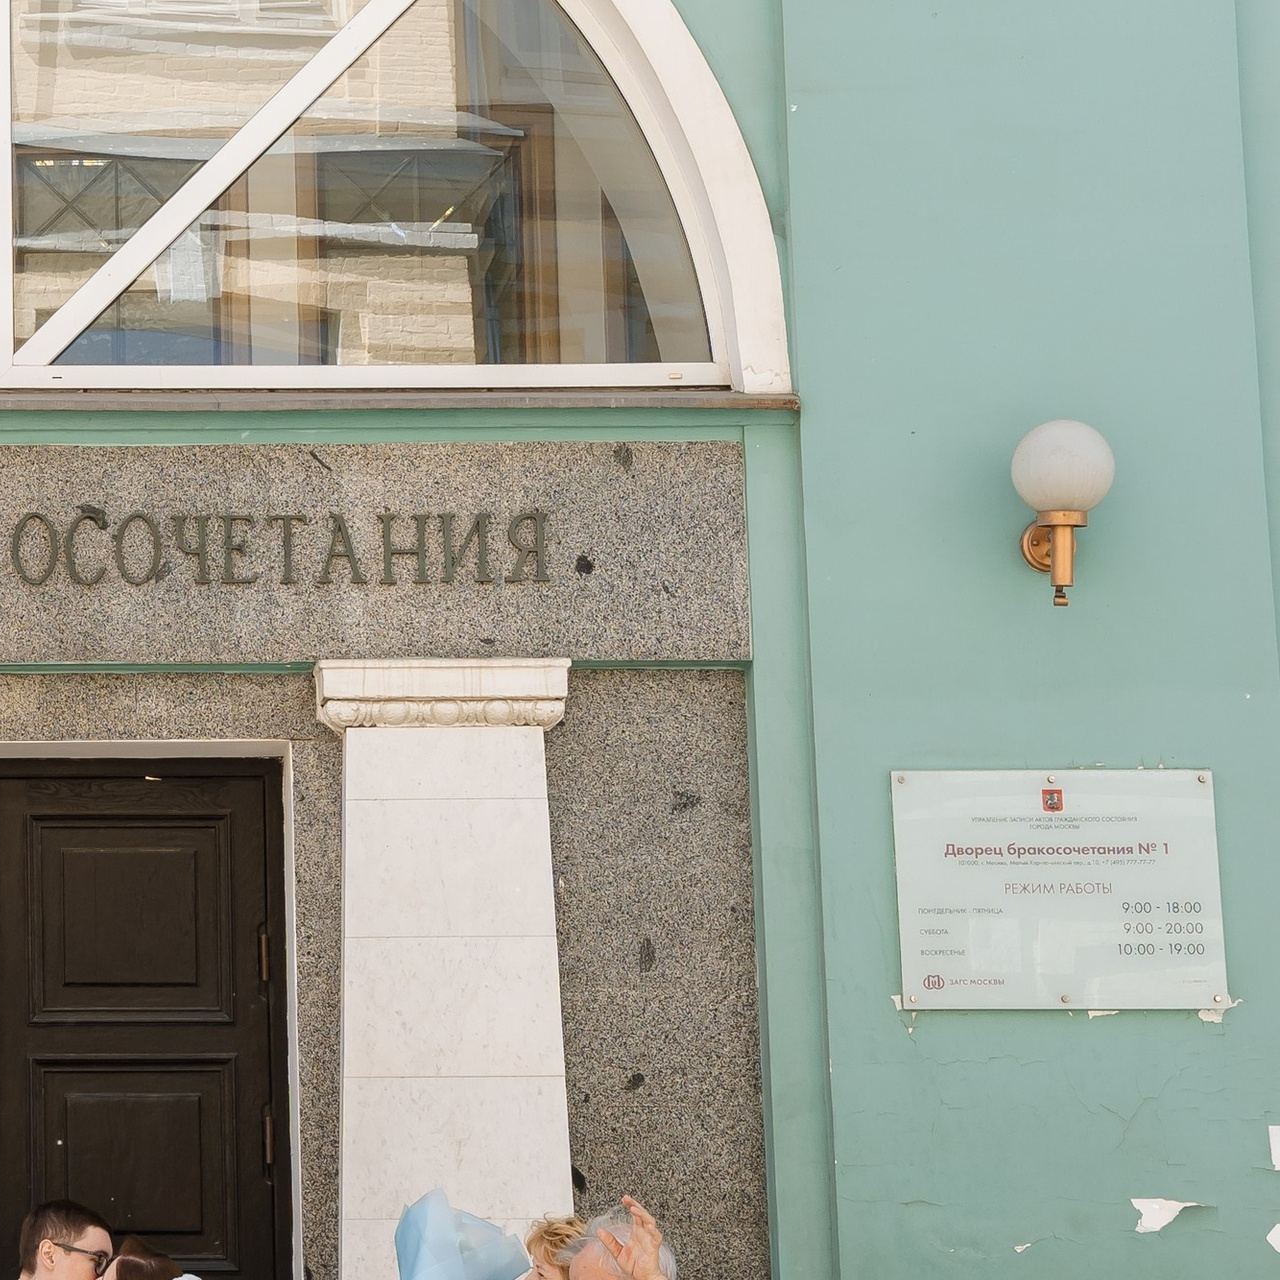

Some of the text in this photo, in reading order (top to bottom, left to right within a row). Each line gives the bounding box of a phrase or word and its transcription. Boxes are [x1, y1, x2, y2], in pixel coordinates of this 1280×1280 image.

[944, 843, 1170, 859] Дворец бракосочетания № 1
[1004, 882, 1113, 895] РЕЖИМ РАБОТЫ
[1121, 901, 1152, 914] 9:00
[1166, 901, 1202, 914] 18:00
[919, 928, 949, 936] СУББОТА
[1123, 922, 1154, 935] 9:00
[1165, 922, 1204, 935] 20:00
[1117, 943, 1155, 955] 10:00
[1168, 942, 1205, 955] 19:00
[949, 978, 1005, 986] ЗАГС МОСКВЫ
